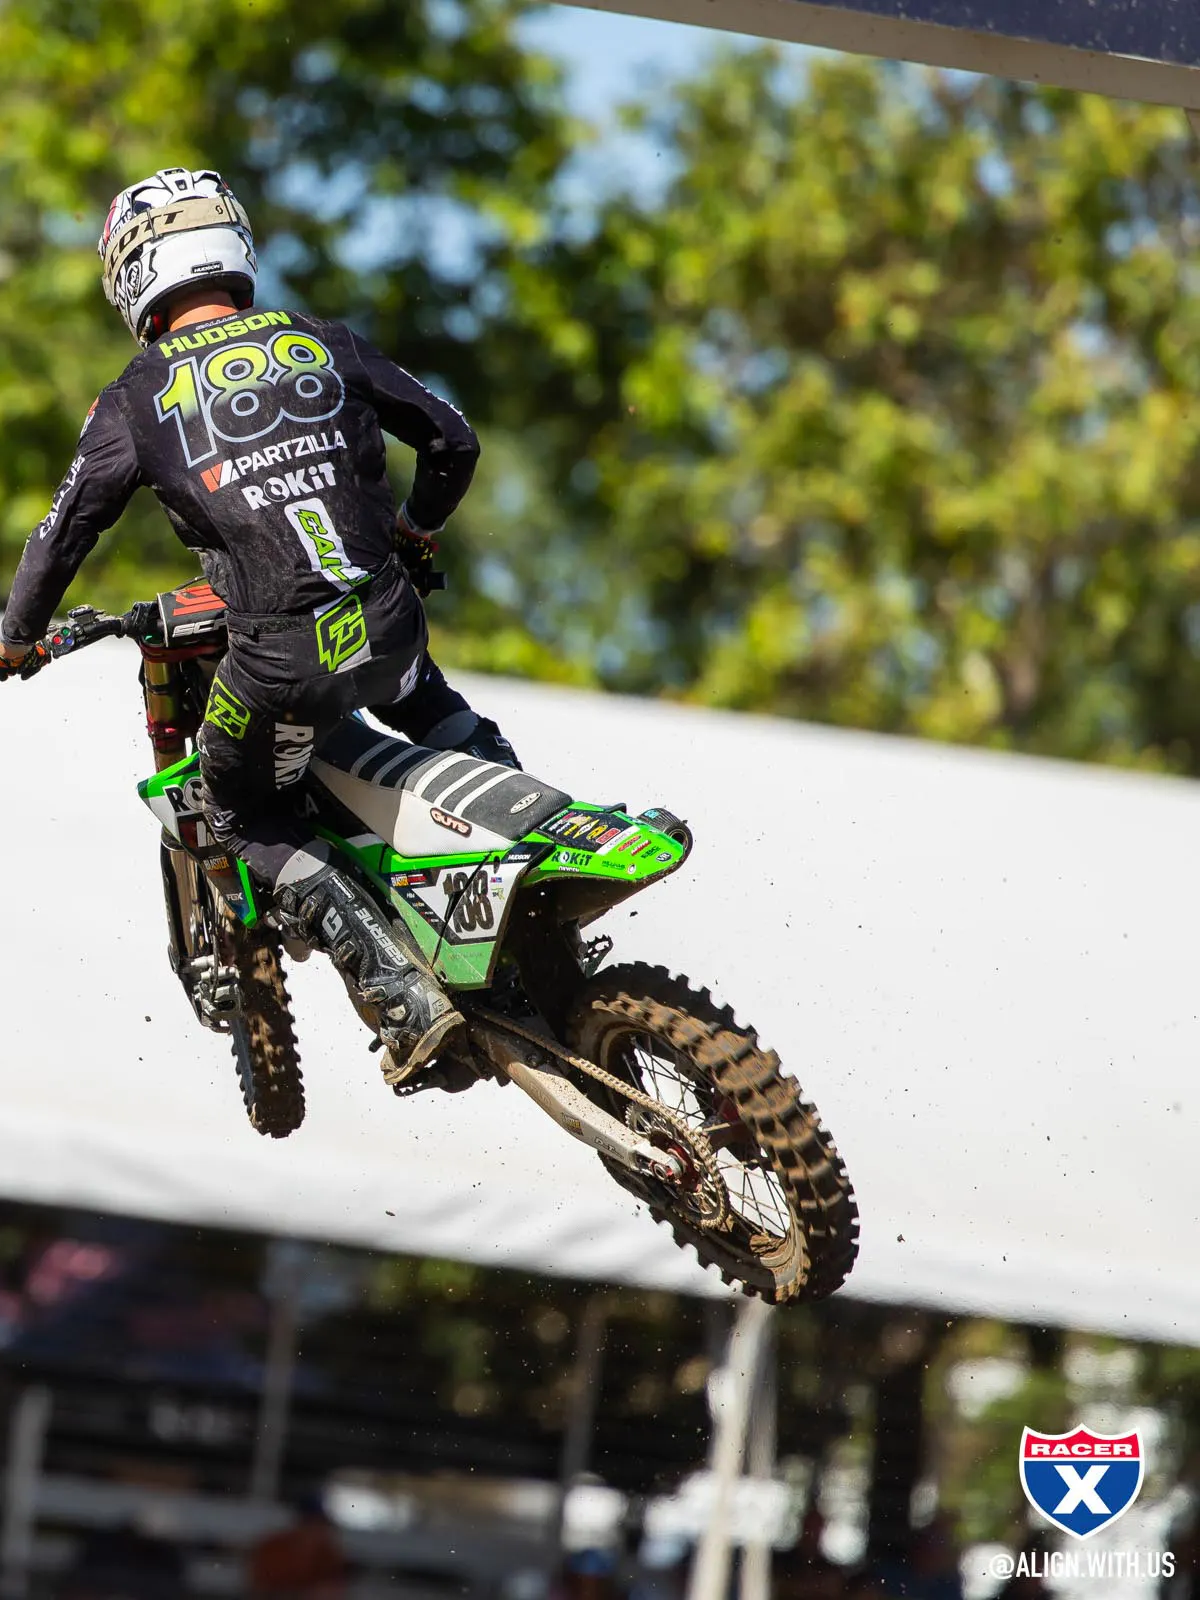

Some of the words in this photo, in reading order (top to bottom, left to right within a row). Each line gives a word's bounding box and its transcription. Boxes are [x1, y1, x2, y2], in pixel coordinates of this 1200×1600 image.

[158, 311, 293, 359] HUDSON
[153, 330, 346, 469] 188
[235, 430, 348, 476] PARTZILLA
[430, 808, 470, 834] GUTS
[442, 869, 495, 934] 188
